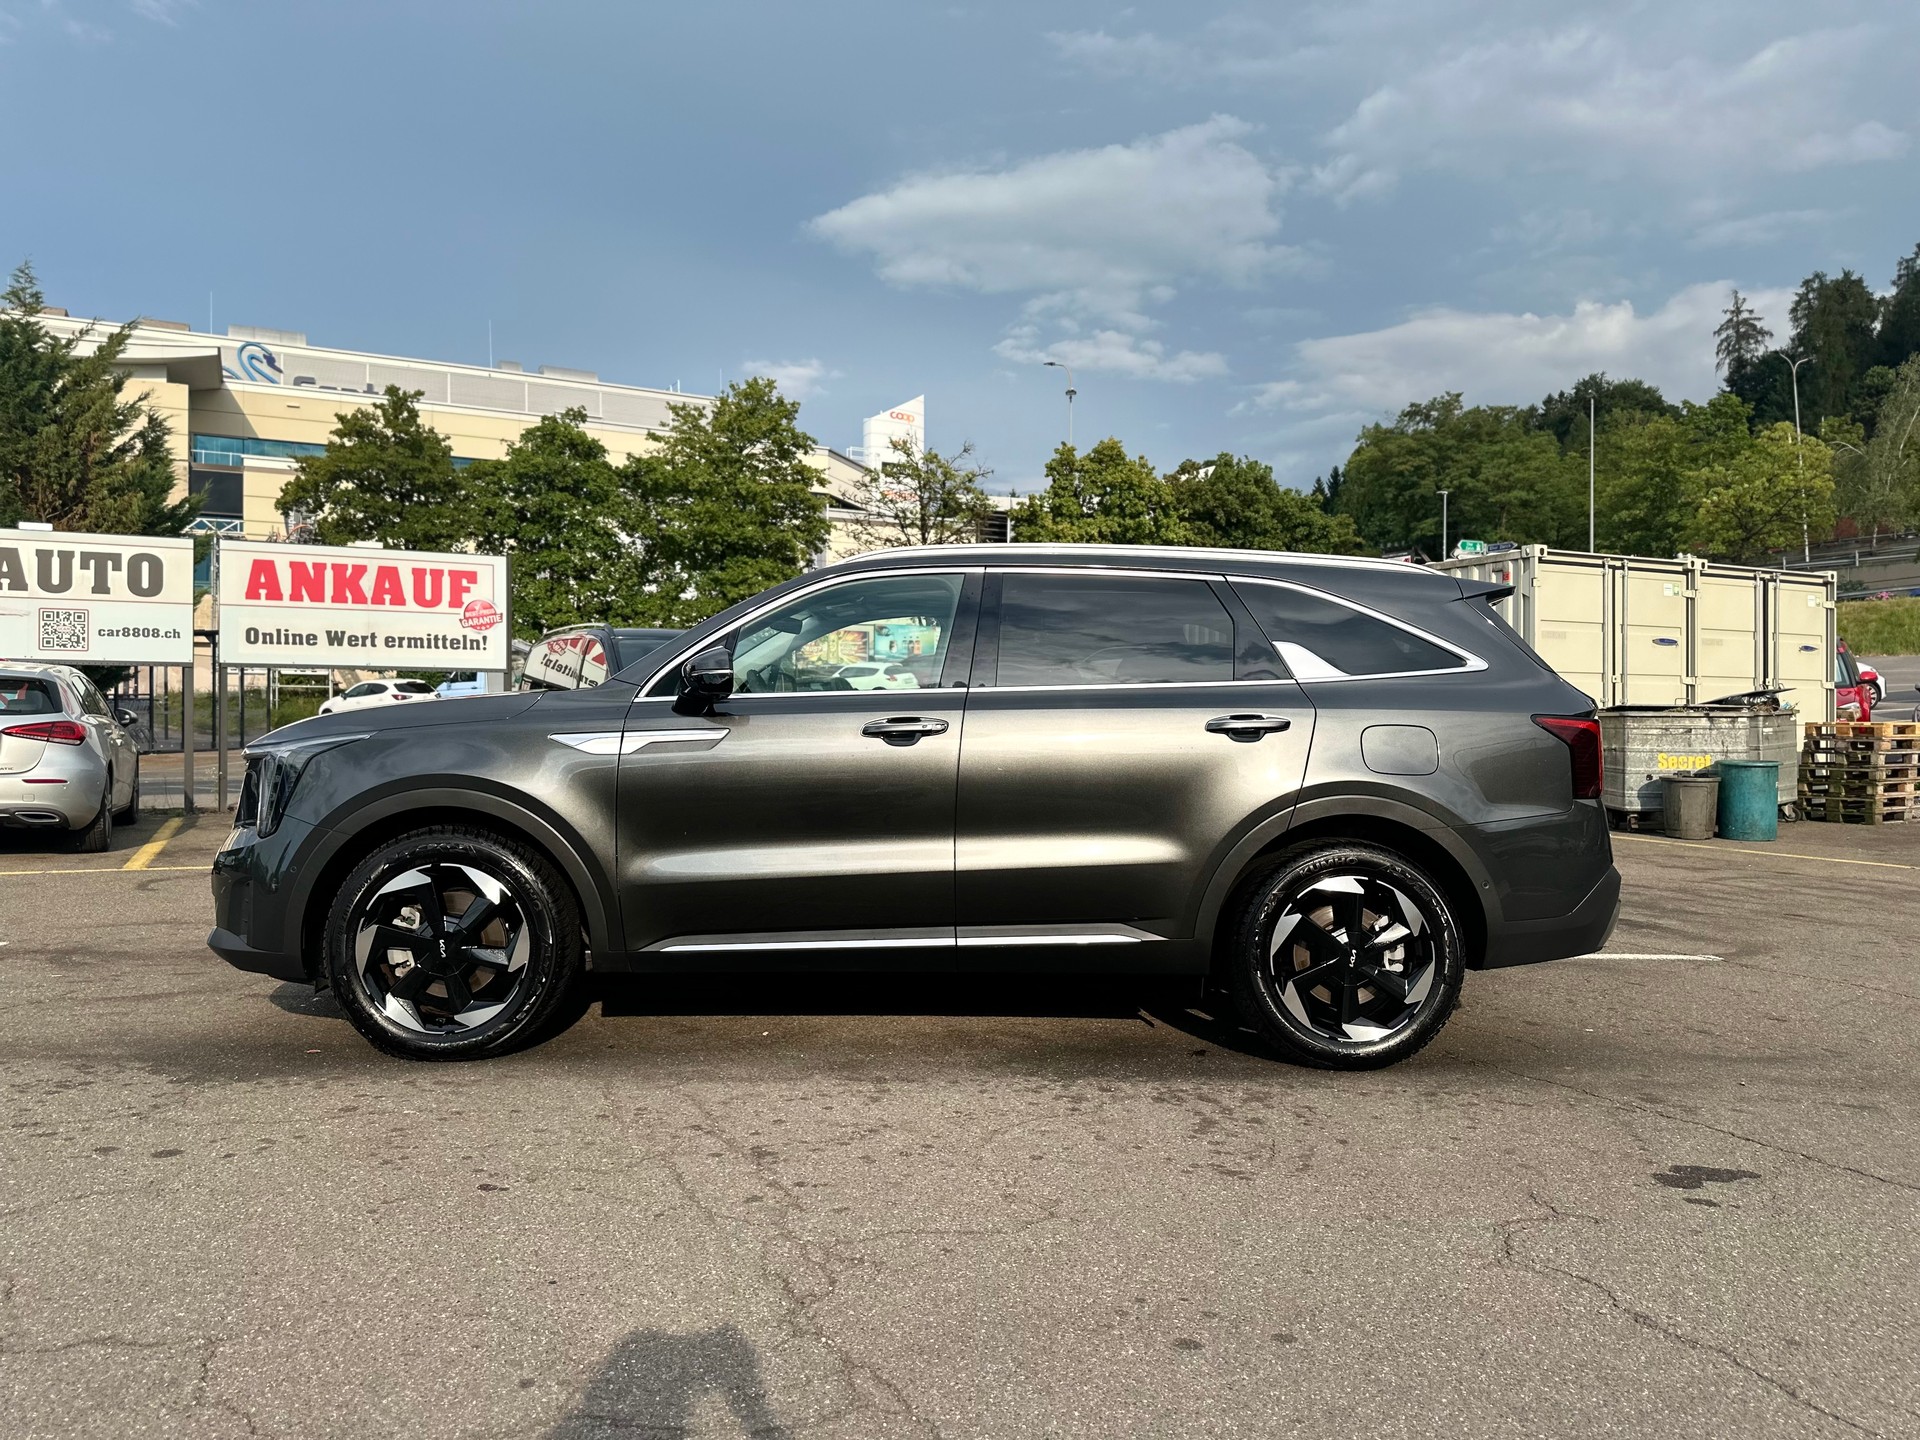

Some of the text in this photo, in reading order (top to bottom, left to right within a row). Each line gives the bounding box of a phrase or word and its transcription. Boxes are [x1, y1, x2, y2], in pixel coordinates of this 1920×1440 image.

[889, 411, 915, 425] coop
[0, 547, 164, 598] AUTO
[245, 559, 478, 609] ANKAUF
[462, 614, 502, 626] GARANTIE
[97, 626, 181, 639] car8808.ch
[245, 626, 488, 651] Online Wert ermitteln!
[1657, 752, 1712, 769] Secret
[1298, 856, 1359, 877] KUMHO
